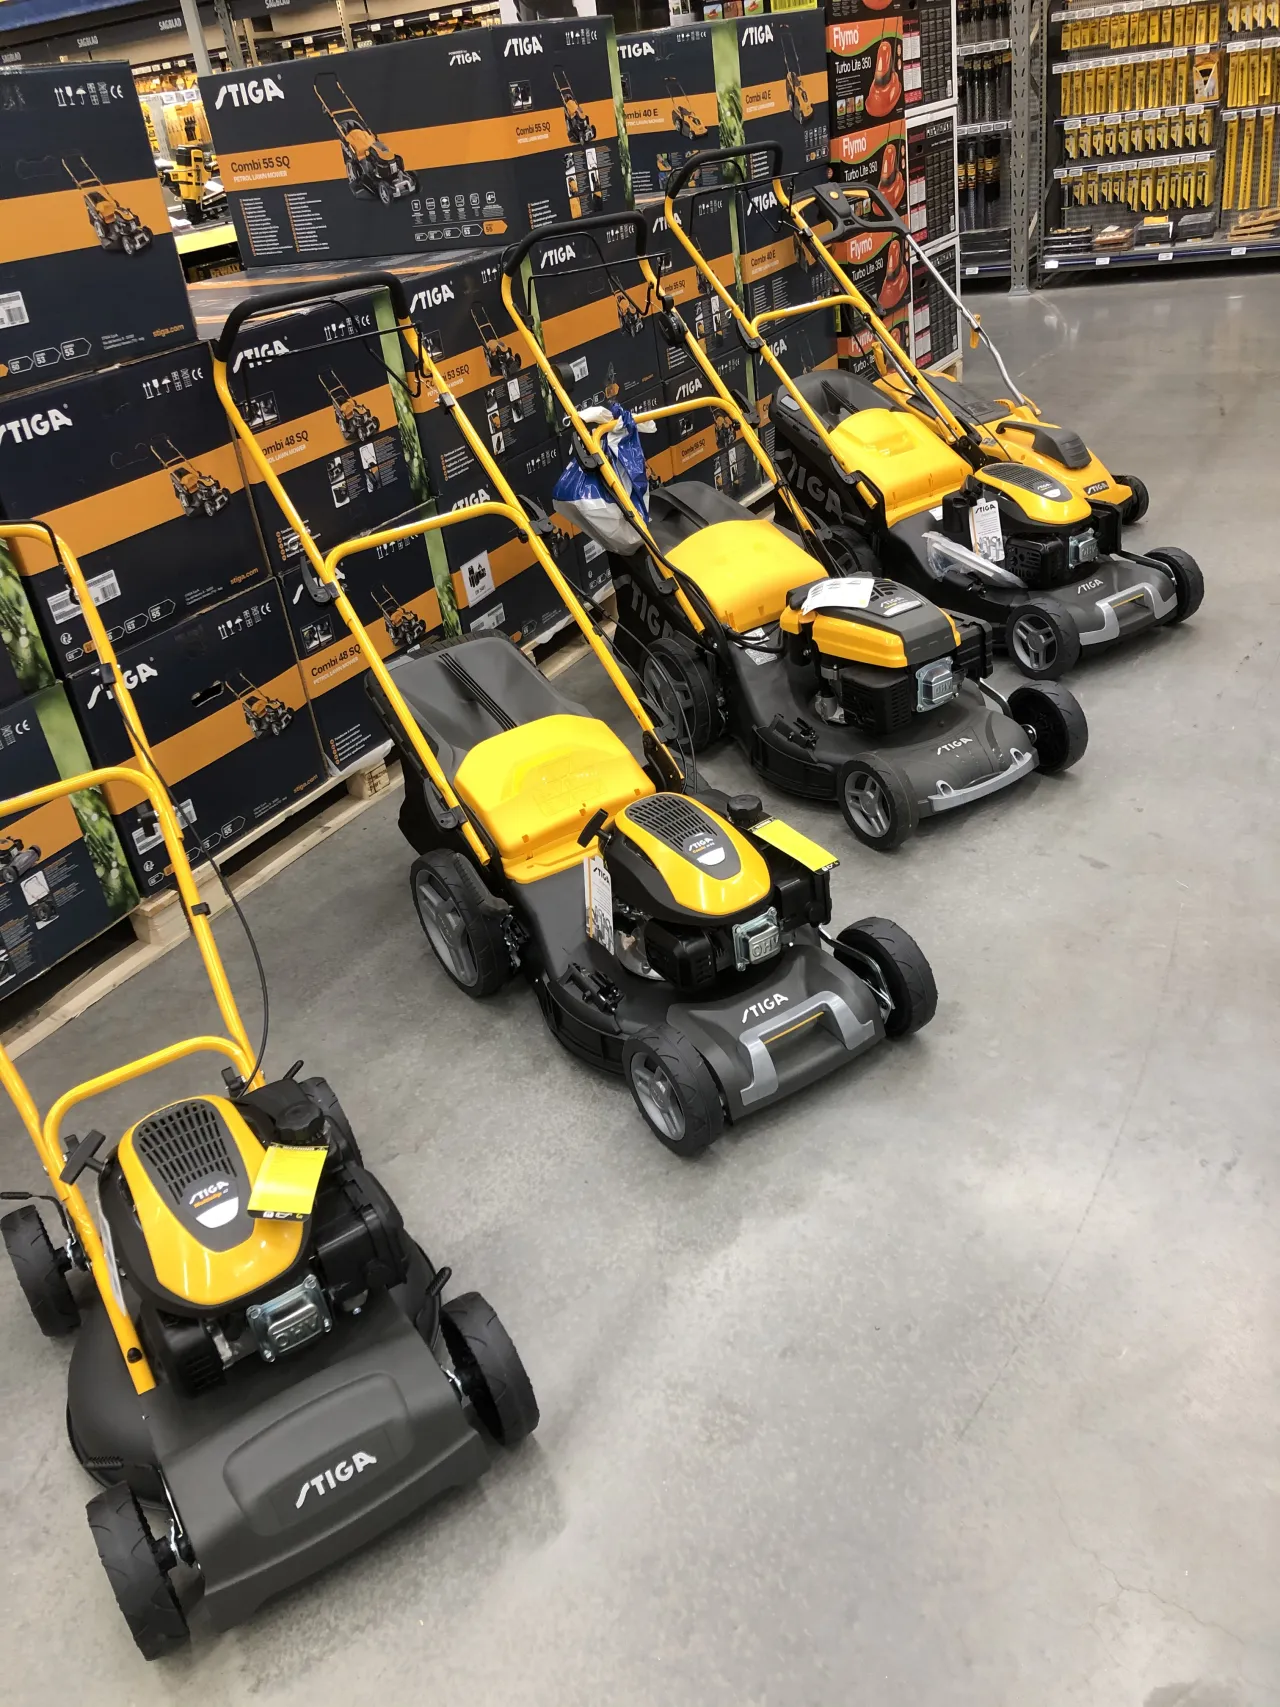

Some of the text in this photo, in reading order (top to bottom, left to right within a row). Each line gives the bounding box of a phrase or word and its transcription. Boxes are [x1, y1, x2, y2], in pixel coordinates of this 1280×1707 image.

[158, 17, 182, 31] SAGBLAD
[77, 35, 99, 48] SAGBLAD
[742, 25, 774, 47] STIGA
[833, 26, 859, 50] Flymo
[504, 36, 543, 58] STIGA
[617, 41, 656, 60] TIGA
[449, 52, 482, 67] STIGA
[835, 56, 872, 75] Turbo Lite 350
[215, 77, 286, 111] STIGA
[745, 90, 772, 105] Combi 40 E
[643, 109, 652, 117] 40
[653, 108, 659, 116] E
[516, 121, 551, 137] Combi 55 SQ
[843, 136, 867, 160] Flymo
[231, 155, 291, 173] Combi 55 SQ
[844, 161, 878, 182] Turbo Lite 350
[268, 170, 288, 179] MOWER
[747, 190, 778, 217] STIGA
[652, 211, 682, 234] STIA
[540, 244, 576, 270] STIGA
[751, 254, 767, 267] Combi
[772, 249, 776, 259] E
[850, 238, 873, 260] Flymo
[852, 256, 884, 282] Turbo Lite 350
[679, 279, 686, 289] SQ
[409, 283, 455, 315] STIGA
[152, 323, 185, 338] stiga.com
[851, 327, 874, 353] Flymo
[36, 356, 46, 365] 53
[65, 348, 75, 357] 55
[233, 338, 290, 374] STIGA
[447, 369, 456, 380] 53
[456, 364, 470, 377] SEQ
[853, 357, 867, 374] Turbo
[675, 377, 703, 402] STIGA
[262, 430, 309, 458] ombi 48 SQ
[290, 444, 306, 457] MOWER
[1088, 482, 1108, 495] STIGA
[452, 487, 491, 512] STIGA
[975, 503, 996, 514] STIGA
[230, 567, 259, 585] stiga.com
[1077, 578, 1104, 595] STIGA
[151, 610, 161, 620] 55
[126, 621, 136, 631] 53
[311, 643, 362, 677] Combi 48 SQ
[87, 662, 158, 711] SGA
[936, 736, 974, 756] STIGA
[293, 773, 319, 794] stiga.com
[224, 827, 233, 836] 55
[688, 837, 713, 852] STIGA
[593, 867, 610, 885] STIGA
[752, 935, 783, 962] OHV
[741, 992, 789, 1024] STIGA
[188, 1181, 230, 1205] STIGA
[296, 1450, 377, 1509] STIGA
